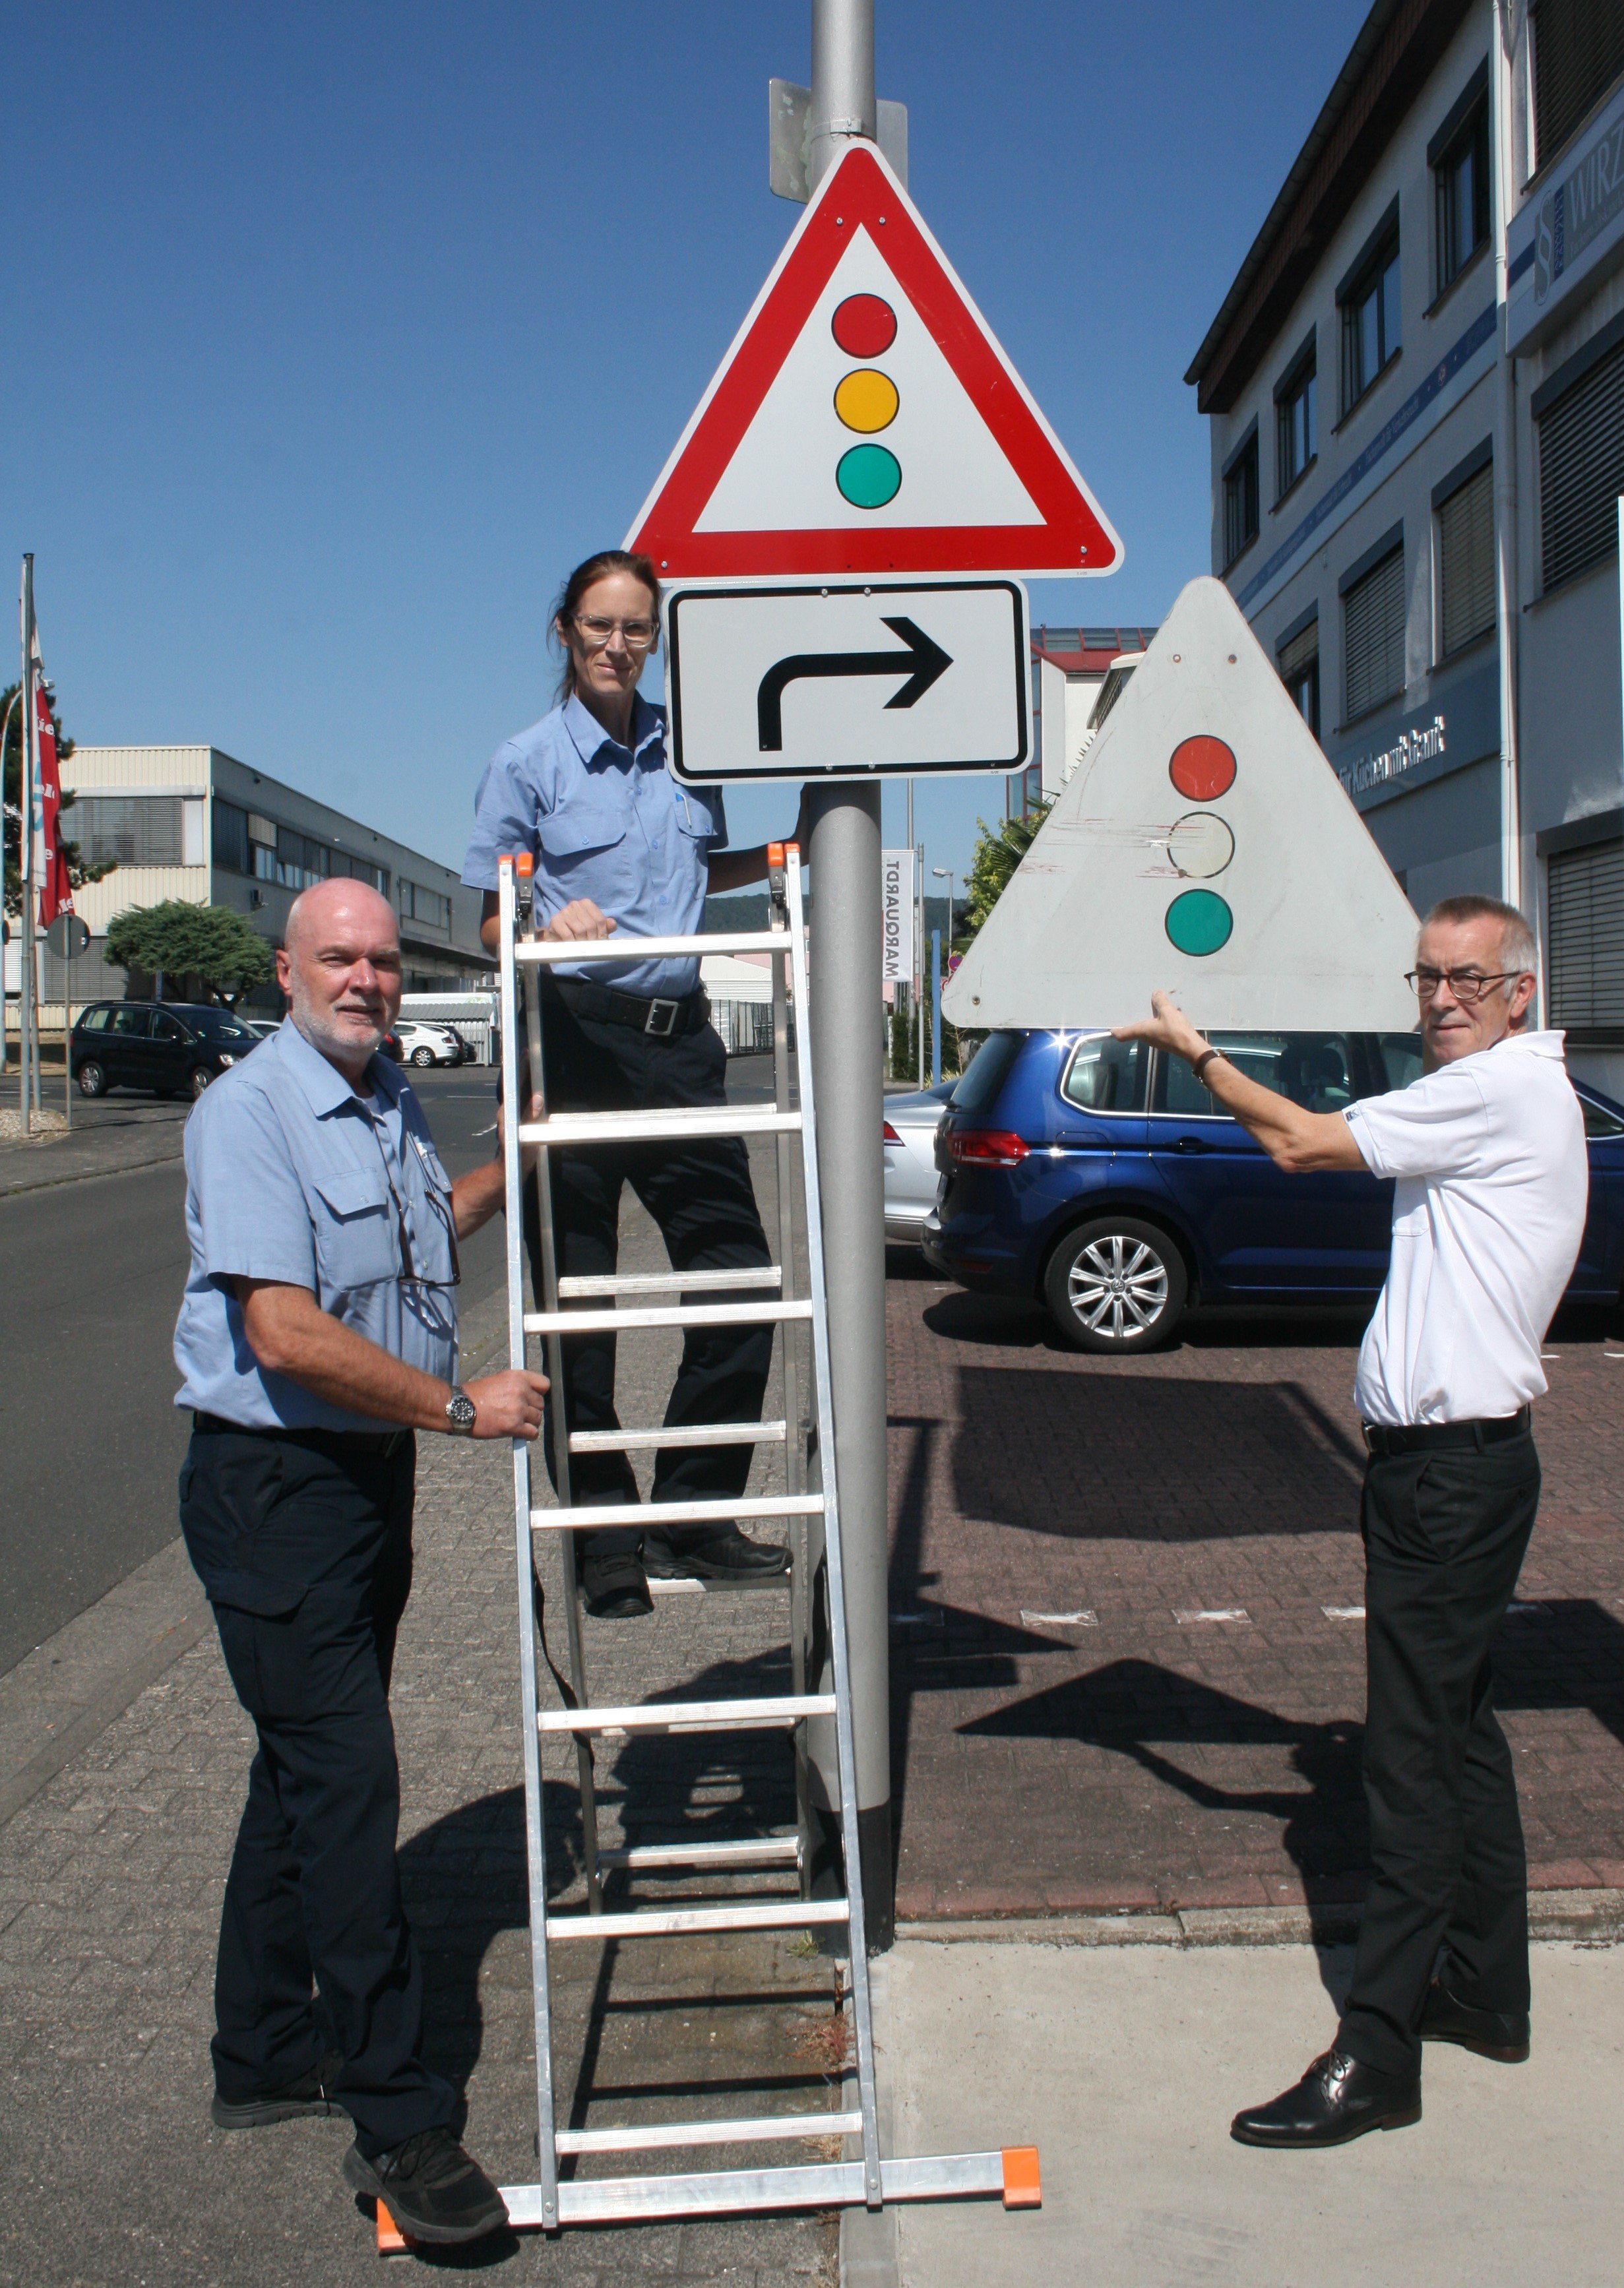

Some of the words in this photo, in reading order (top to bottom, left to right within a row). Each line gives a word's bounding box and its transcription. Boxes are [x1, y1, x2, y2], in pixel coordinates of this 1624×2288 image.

[1352, 751, 1389, 795] Küchen
[1389, 735, 1408, 777] mit
[1408, 716, 1445, 767] Granit
